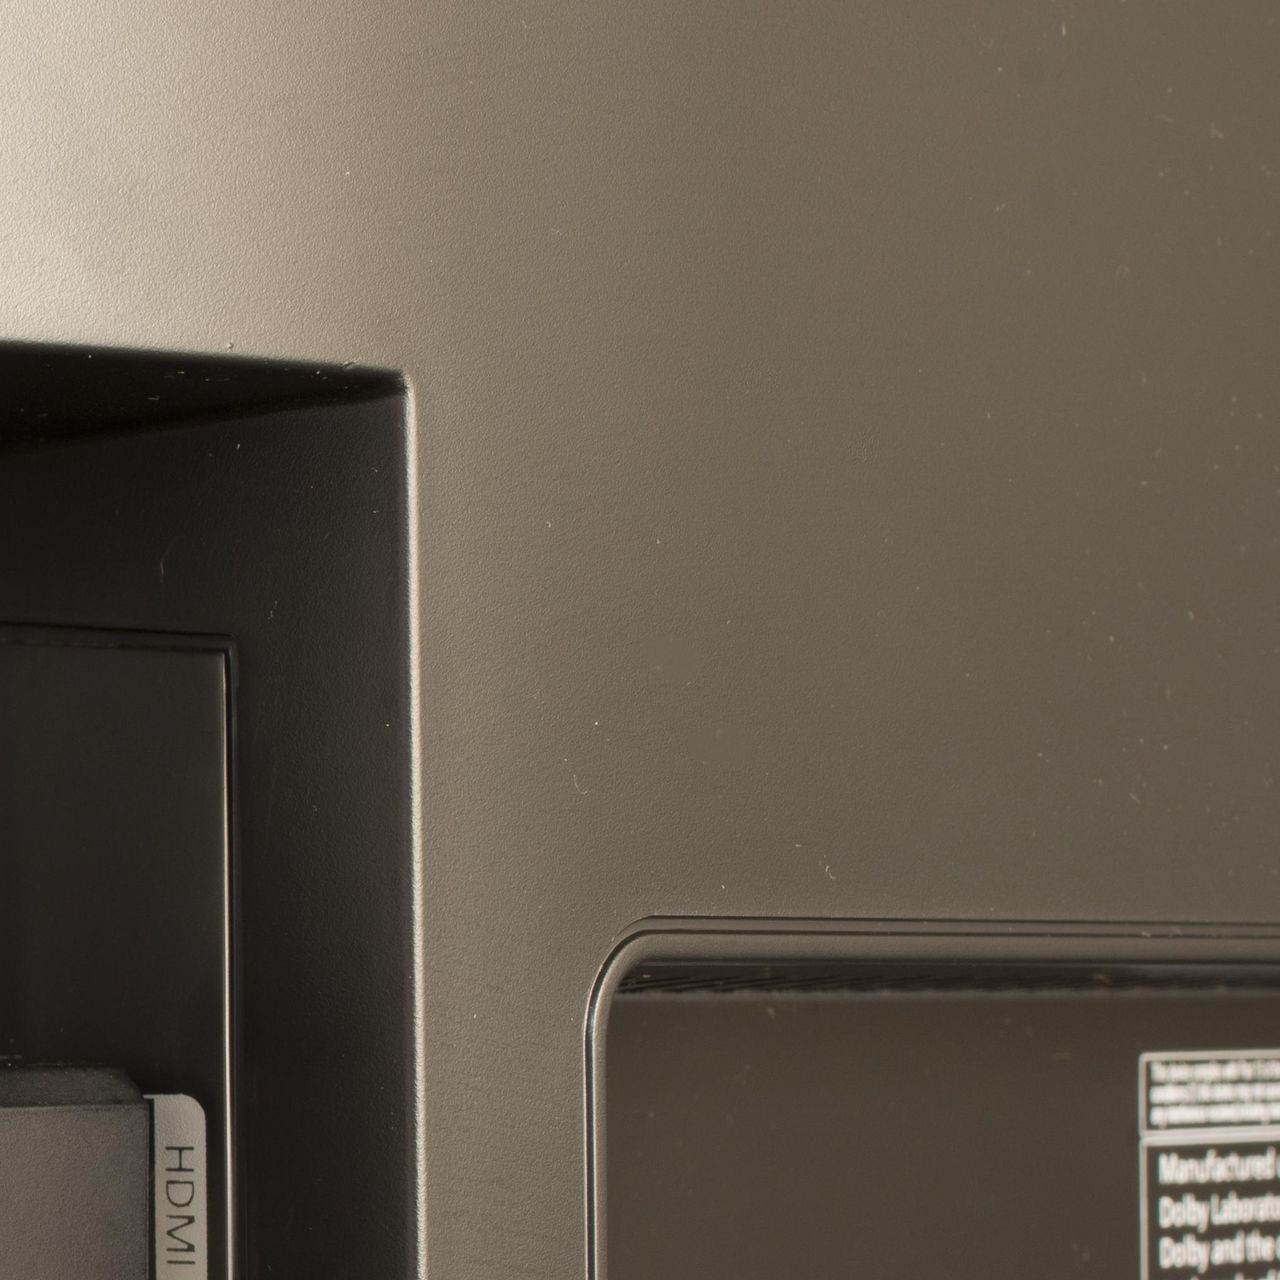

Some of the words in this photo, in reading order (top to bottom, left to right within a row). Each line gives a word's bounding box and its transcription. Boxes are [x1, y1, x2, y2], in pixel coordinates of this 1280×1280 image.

[1158, 1148, 1276, 1184] Manufactured
[164, 1145, 196, 1265] HDMI
[1158, 1192, 1210, 1233] Dolby
[1158, 1232, 1210, 1273] Dolby
[1210, 1229, 1245, 1265] and
[1246, 1228, 1276, 1262] the
